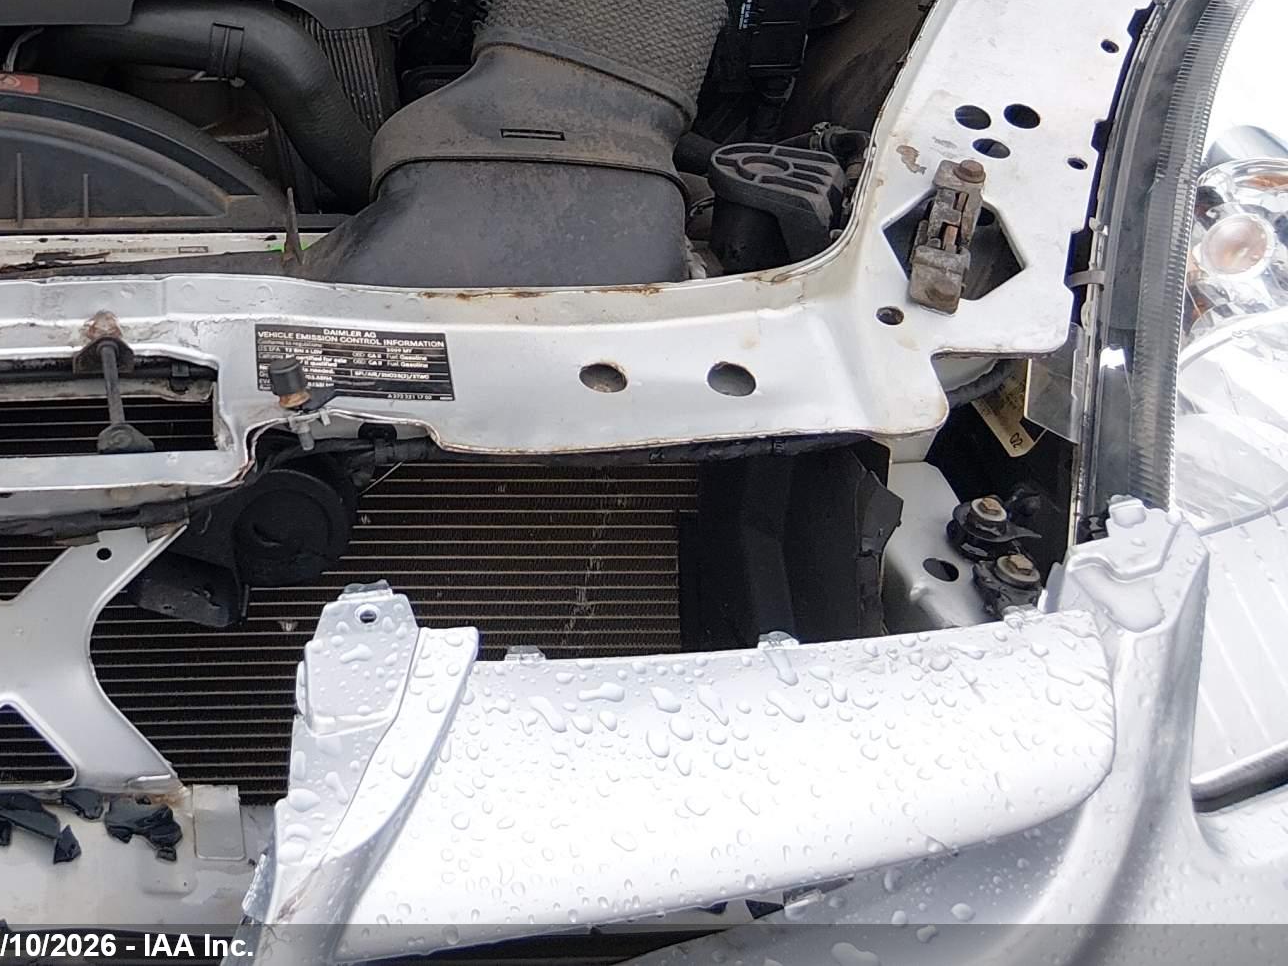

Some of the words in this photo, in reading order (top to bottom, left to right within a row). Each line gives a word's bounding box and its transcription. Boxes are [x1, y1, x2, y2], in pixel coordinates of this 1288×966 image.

[295, 333, 338, 342] EMISSION
[339, 336, 382, 345] CONTROL
[383, 339, 444, 347] INFORMATION
[323, 329, 362, 337] DAIMLER
[363, 331, 377, 339] AG
